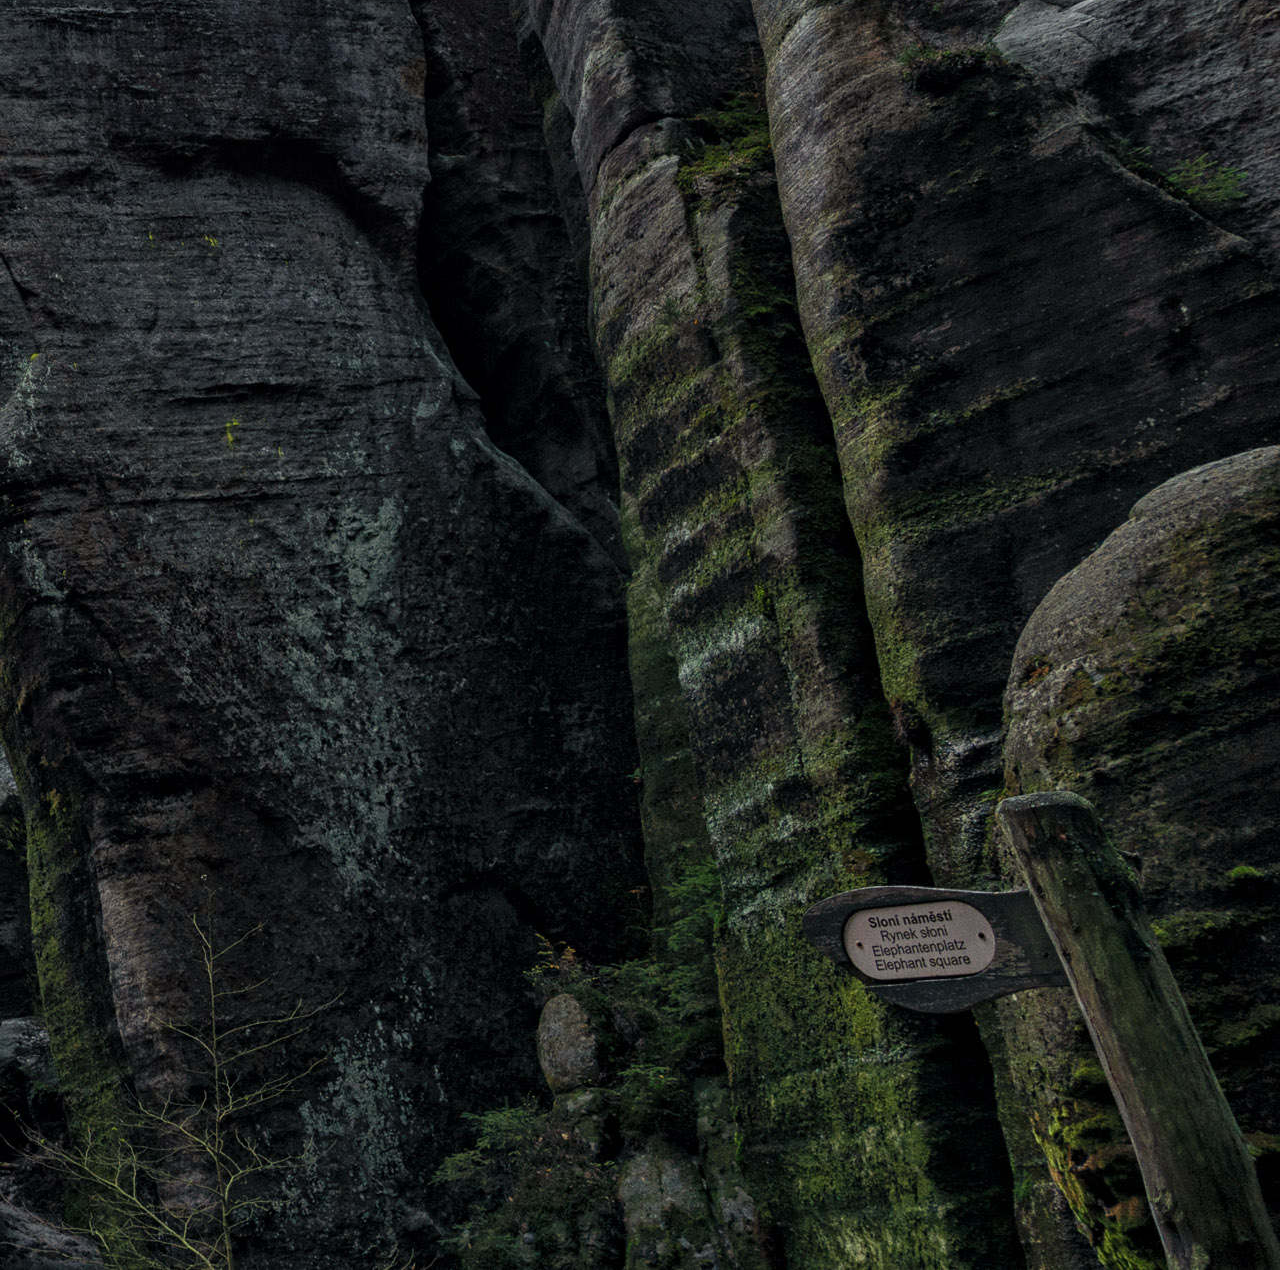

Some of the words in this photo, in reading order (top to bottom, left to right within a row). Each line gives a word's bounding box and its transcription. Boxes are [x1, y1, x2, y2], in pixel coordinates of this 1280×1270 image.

[868, 914, 900, 929] Sloní
[903, 909, 953, 925] náměstí
[880, 928, 918, 944] Rynek
[920, 925, 948, 938] słoni
[872, 940, 967, 959] Elephantenplatz
[875, 958, 927, 973] Elephant
[929, 955, 971, 969] square
